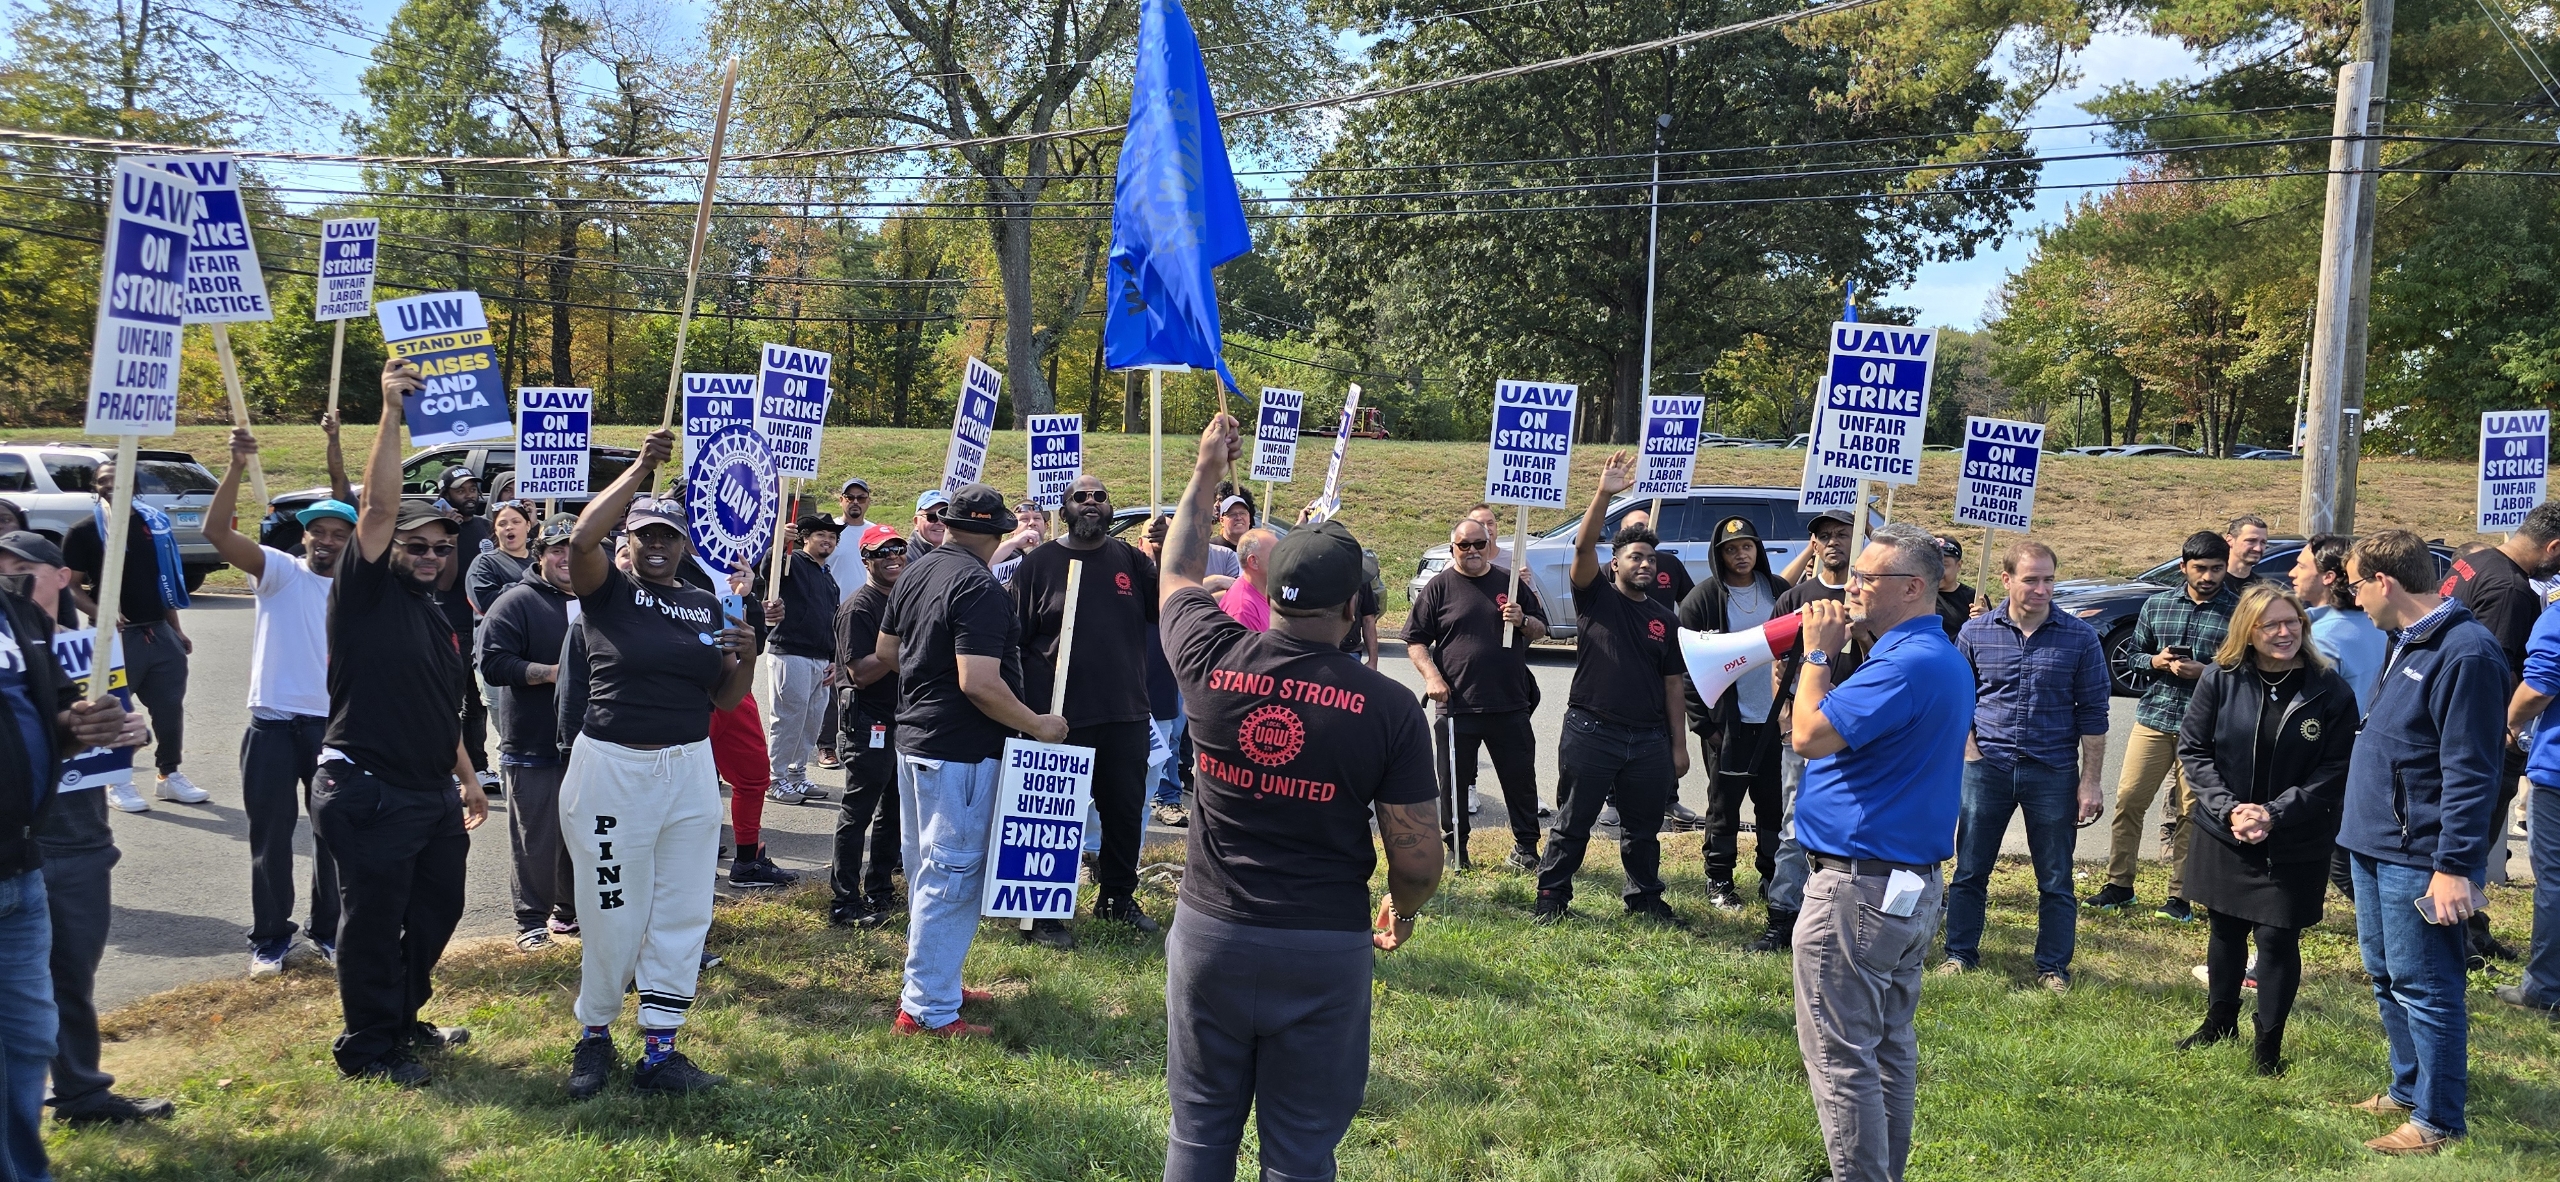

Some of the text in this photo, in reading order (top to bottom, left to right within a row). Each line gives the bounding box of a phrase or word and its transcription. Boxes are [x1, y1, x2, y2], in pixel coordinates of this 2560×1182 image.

[123, 172, 193, 227] UAW
[194, 195, 209, 220] N
[327, 222, 376, 238] UAW
[140, 233, 171, 273] ON
[340, 242, 361, 257] ON
[324, 257, 373, 275] STRIKE
[186, 276, 243, 294] ABOR
[329, 277, 366, 290] UNFAIR
[112, 272, 184, 317] STRIKE
[329, 289, 363, 302] LABOR
[184, 295, 265, 314] RACTICE
[320, 301, 369, 315] PRACTICE
[397, 299, 463, 332] UAW
[117, 326, 173, 358] UNFAIR
[396, 333, 484, 355] STAND UP
[1836, 328, 1931, 356] UAW
[768, 348, 829, 376] UAW
[115, 359, 168, 389] LABOR
[969, 363, 1000, 397] UAW
[1859, 361, 1896, 385] ON
[424, 374, 478, 397] AND
[687, 377, 754, 395] UAW
[784, 377, 808, 398] ON
[420, 391, 490, 416] COLA
[523, 392, 589, 409] UAW
[1264, 391, 1302, 408] UAW
[1501, 384, 1574, 408] UAW
[1831, 383, 1919, 412] STRIKE
[96, 392, 174, 421] PRACTICE
[707, 400, 733, 416] ON
[763, 396, 822, 420] STRIKE
[973, 396, 988, 420] ON
[1652, 400, 1702, 415] UAW
[542, 414, 569, 431] ON
[1031, 417, 1079, 433] UAW
[1273, 410, 1288, 425] ON
[1519, 410, 1548, 430] ON
[1838, 414, 1906, 436] UNFAIR
[2486, 415, 2546, 435] UAW
[767, 421, 813, 440] UNFAIR
[959, 414, 990, 446] STRIKE
[1260, 424, 1296, 441] STRIKE
[1663, 420, 1684, 436] ON
[1971, 421, 2042, 445] UAW
[523, 432, 587, 448] STRIKE
[769, 437, 808, 455] LABOR
[1046, 436, 1065, 452] ON
[1262, 442, 1290, 455] UNFAIR
[1497, 429, 1567, 451] STRIKE
[1646, 437, 1695, 452] STRIKE
[1839, 433, 1900, 455] LABOR
[2504, 439, 2528, 457] ON
[530, 453, 579, 466] UNFAIR
[775, 455, 816, 472] ACTICE
[957, 442, 982, 466] UNFAIR
[1032, 451, 1079, 468] STRIKE
[1262, 454, 1287, 466] LABOR
[1503, 453, 1557, 471] UNFAIR
[1649, 457, 1687, 468] UNFAIR
[1823, 450, 1914, 476] PRACTICE
[1988, 445, 2016, 464] ON
[532, 467, 576, 479] LABOR
[954, 460, 977, 482] LABOR
[1038, 470, 1074, 482] UNFAIR
[1253, 465, 1291, 478] PRACTICE
[1649, 469, 1683, 481] LABOR
[1966, 460, 2034, 484] STRIKE
[2486, 458, 2543, 477] STRIKE
[521, 480, 585, 493] PRACTICE
[1503, 469, 1552, 486] LABOR
[1490, 483, 1562, 502] PRACTICE
[1638, 482, 1688, 493] PRACTICE
[1971, 481, 2023, 500] UNFAIR
[2492, 481, 2536, 496] UNFAIR
[719, 473, 759, 525] UAW
[1805, 490, 1859, 505] PRACTIC
[1972, 495, 2018, 513] LABOR
[2494, 496, 2533, 511] LABOR
[1959, 506, 2028, 527] PRACTICE
[2483, 511, 2527, 526] PRACTI
[56, 636, 97, 673] AW
[1209, 669, 1365, 714] STAND STRONG
[1254, 725, 1290, 748] UAW
[1011, 749, 1090, 775] PRACTICE
[1022, 772, 1076, 795] LABOR
[1199, 752, 1336, 802] STAND UNITED
[1017, 793, 1076, 816] UNFAIR
[1003, 821, 1080, 850] STRIKE
[594, 815, 625, 910] PINK
[1023, 851, 1056, 877] ON
[991, 885, 1073, 912] UAW
